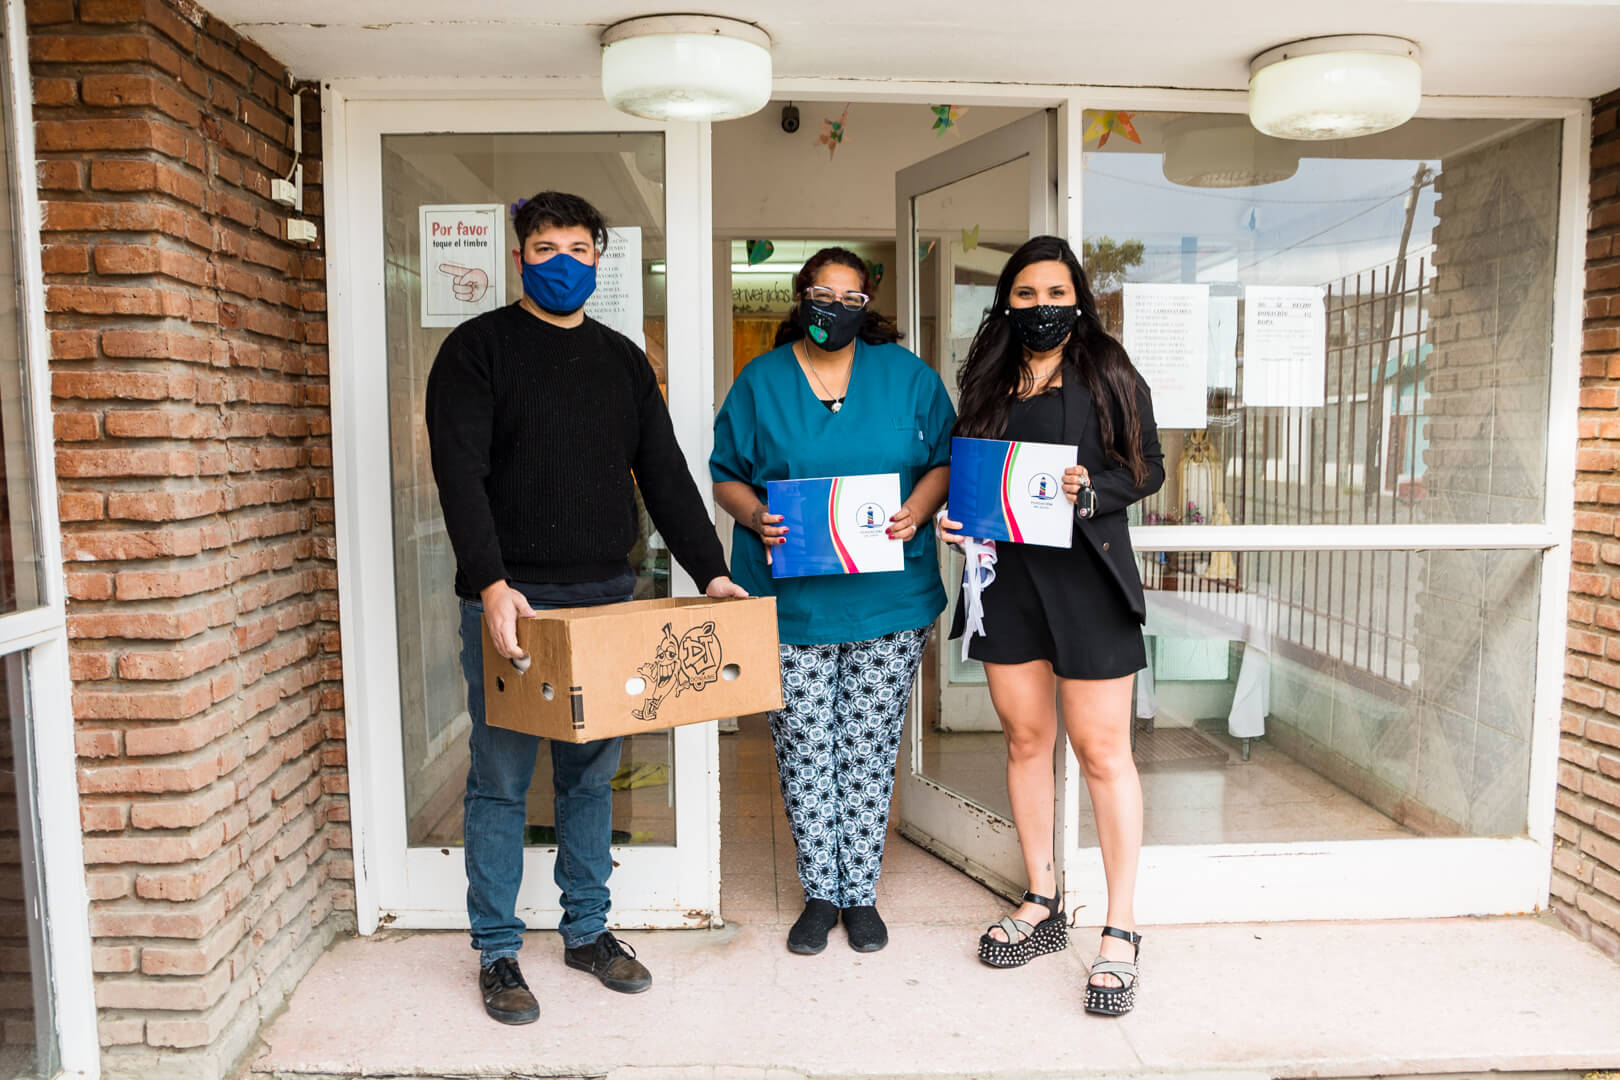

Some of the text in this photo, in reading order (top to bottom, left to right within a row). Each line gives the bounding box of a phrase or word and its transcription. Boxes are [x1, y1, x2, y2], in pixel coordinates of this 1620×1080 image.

[432, 220, 488, 236] Por favor
[433, 238, 488, 250] toque el timbre
[683, 635, 716, 675] DJ
